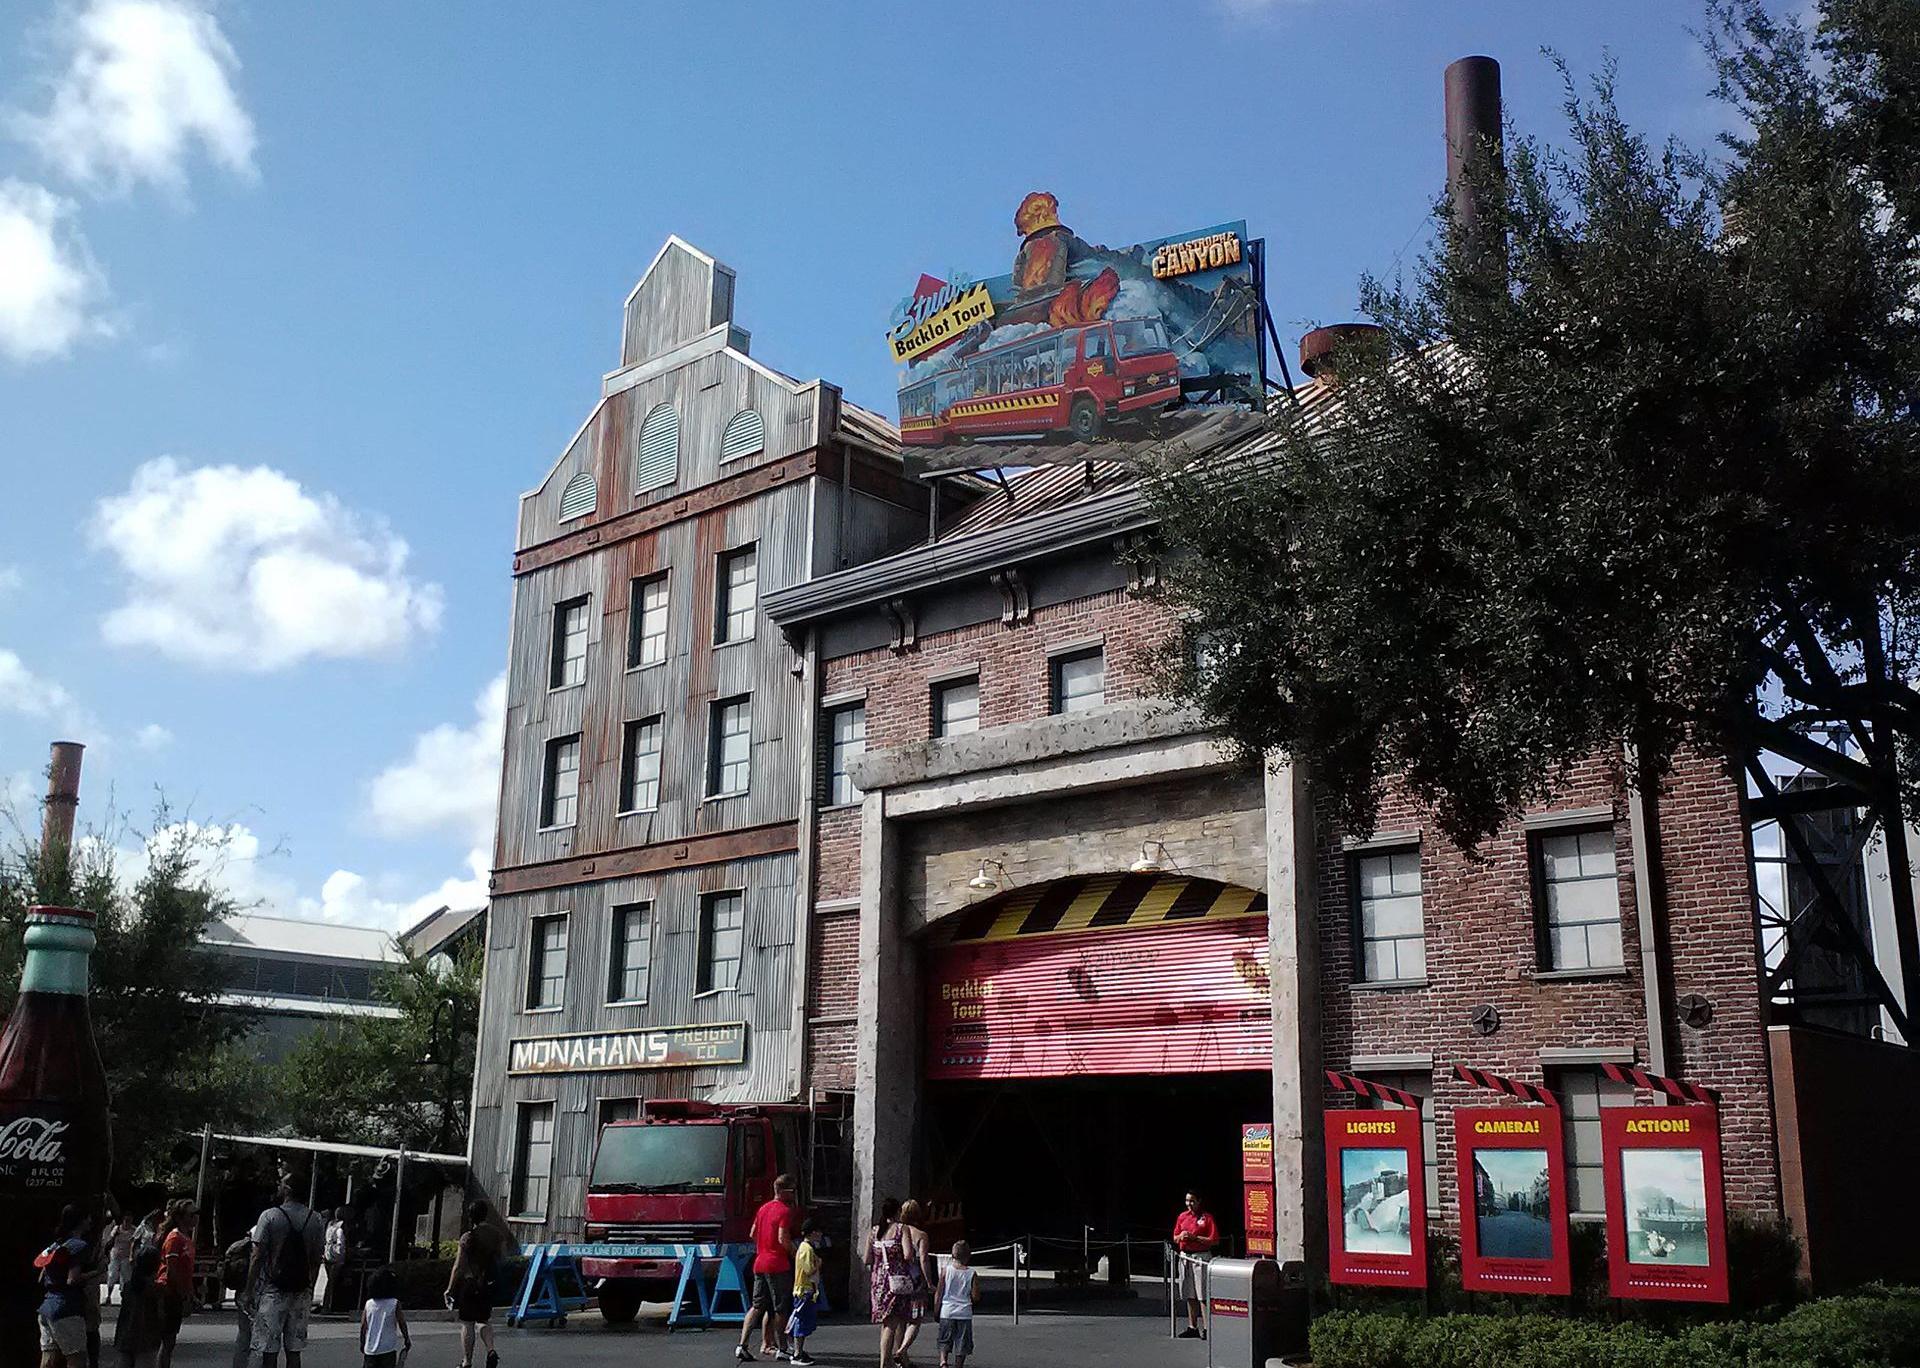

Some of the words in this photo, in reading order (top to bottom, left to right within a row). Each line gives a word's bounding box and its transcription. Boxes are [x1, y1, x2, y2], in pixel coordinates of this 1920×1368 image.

[1158, 231, 1235, 256] CATASTROPHE
[1152, 239, 1240, 279] CANYON
[895, 318, 950, 357] Backlot
[952, 301, 986, 325] Tour
[942, 979, 993, 999] Backlot
[952, 1001, 983, 1018] Tour
[514, 1032, 668, 1070] MONAHANS
[675, 1026, 738, 1043] FREIGHT
[697, 1045, 719, 1060] CO.
[1346, 1121, 1397, 1134] LIGHTS!
[1474, 1121, 1541, 1134] CAMERA!
[1626, 1118, 1691, 1133] ACTION!
